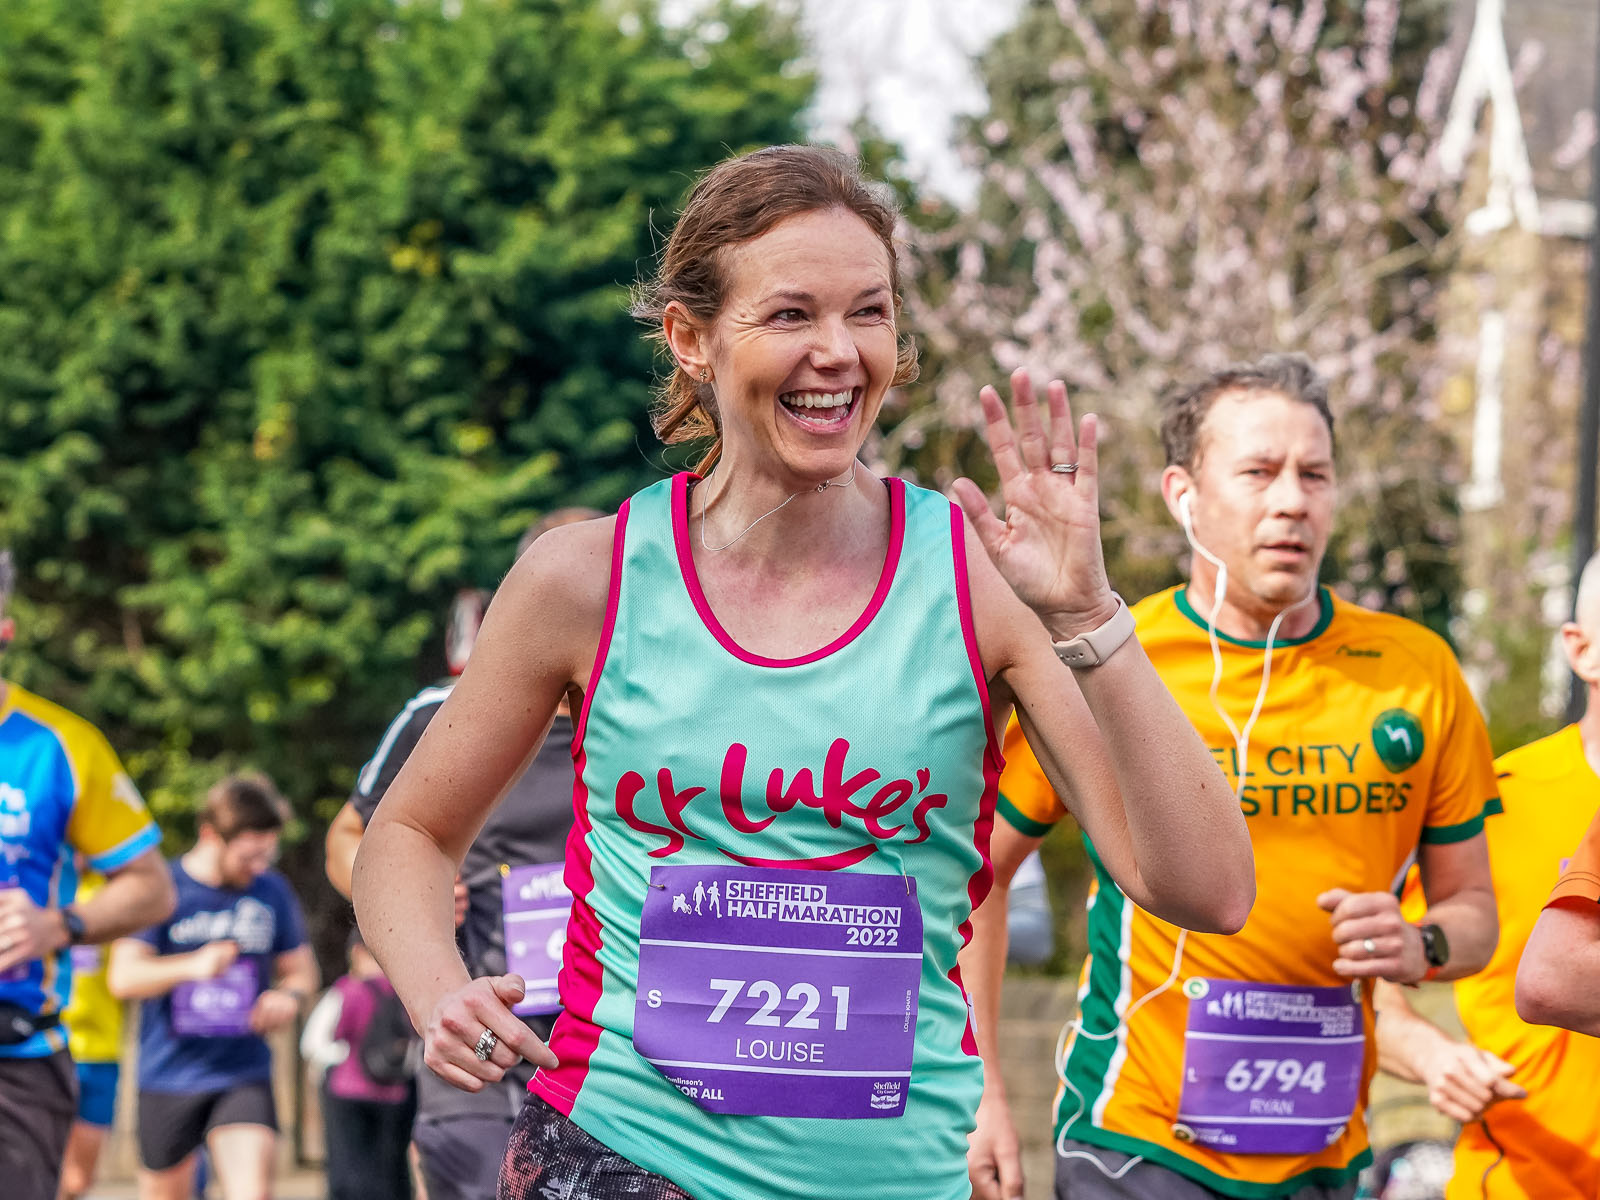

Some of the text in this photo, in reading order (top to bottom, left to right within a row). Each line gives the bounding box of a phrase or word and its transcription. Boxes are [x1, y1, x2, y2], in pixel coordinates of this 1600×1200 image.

[1266, 743, 1361, 776] CITY
[719, 737, 948, 844] Luke's
[728, 882, 825, 902] SHEFFIELD
[727, 901, 900, 925] HALF MARATHON
[846, 927, 899, 947] 2022
[646, 989, 663, 1008] S
[706, 978, 850, 1031] 7221
[735, 1038, 825, 1063] LOUISE
[1225, 1058, 1326, 1094] 6794
[701, 1088, 725, 1101] ALL
[1249, 1098, 1295, 1115] RYAN
